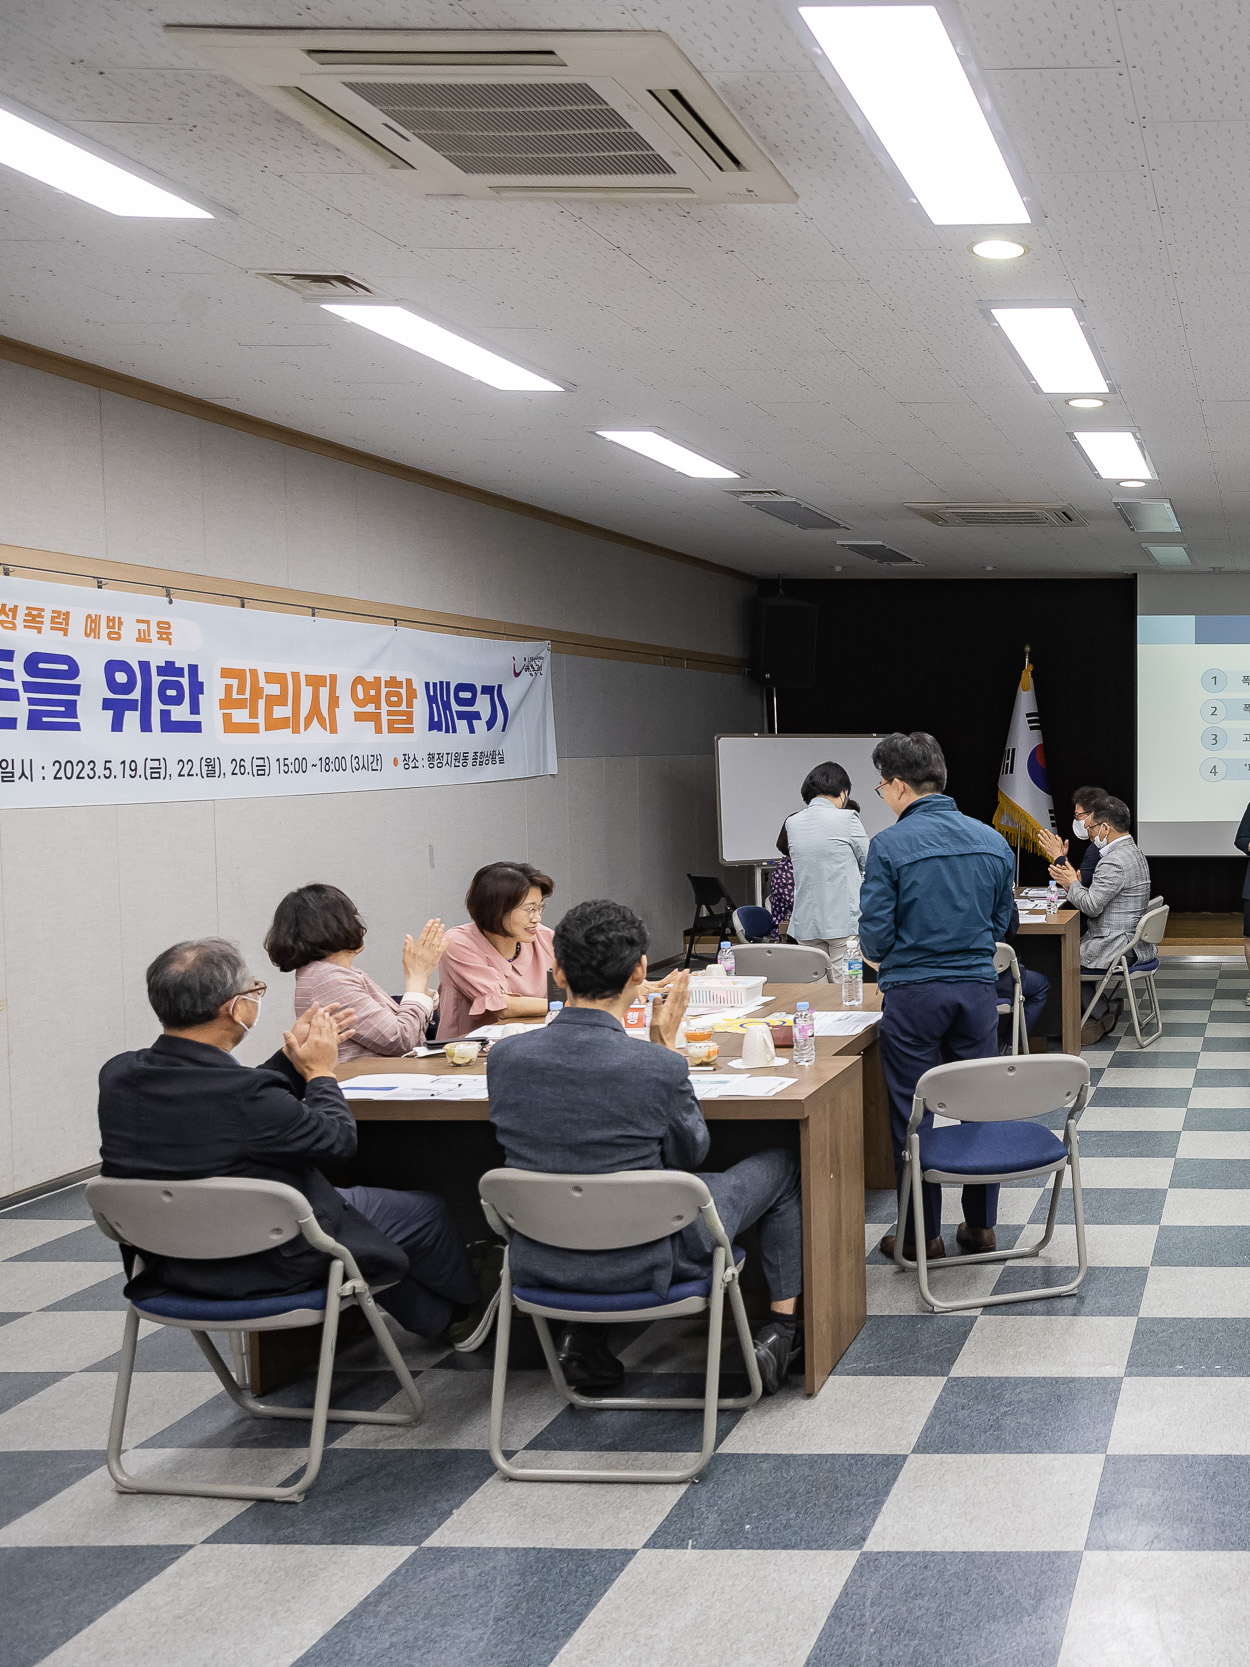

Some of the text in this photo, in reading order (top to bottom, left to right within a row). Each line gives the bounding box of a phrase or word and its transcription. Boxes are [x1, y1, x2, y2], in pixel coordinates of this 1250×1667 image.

[0, 603, 173, 646] 성폭력 예방 교육
[1210, 675, 1218, 686] 1
[101, 659, 205, 734] 위한
[218, 667, 340, 735] 관리자
[350, 675, 417, 735] 역할
[424, 681, 509, 735] 배우기
[1210, 706, 1218, 716] 2
[1210, 733, 1218, 745] 3
[0, 758, 34, 782] 일시
[52, 757, 172, 781] 2023.5.19.(금),
[177, 757, 226, 779] 22.(월),
[230, 756, 271, 777] 26.(금)
[275, 756, 308, 775] 15:00
[350, 753, 383, 773] (3시간)
[402, 753, 420, 770] 장소
[427, 751, 470, 769] 행정지원동
[471, 749, 505, 767] 종합상황실
[1209, 764, 1218, 776] 4
